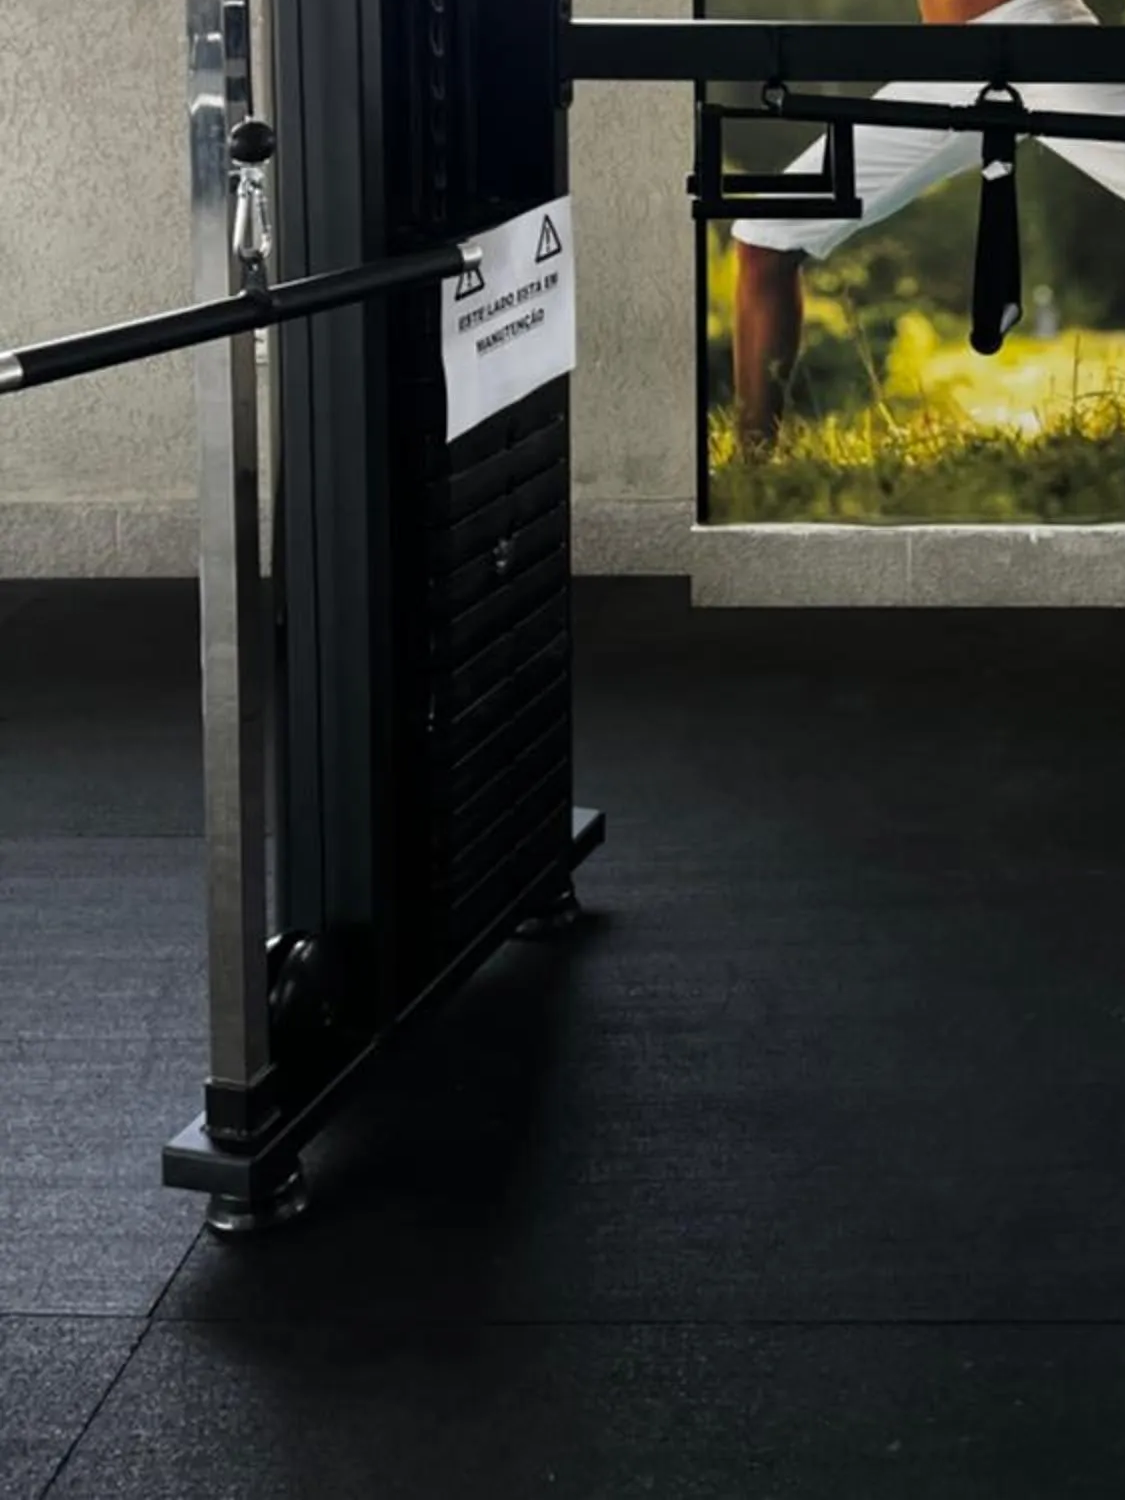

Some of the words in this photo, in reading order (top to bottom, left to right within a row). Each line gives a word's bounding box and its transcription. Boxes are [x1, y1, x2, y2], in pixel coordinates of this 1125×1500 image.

[458, 306, 485, 332] ESTE
[486, 292, 515, 317] LADO
[543, 271, 559, 290] EM
